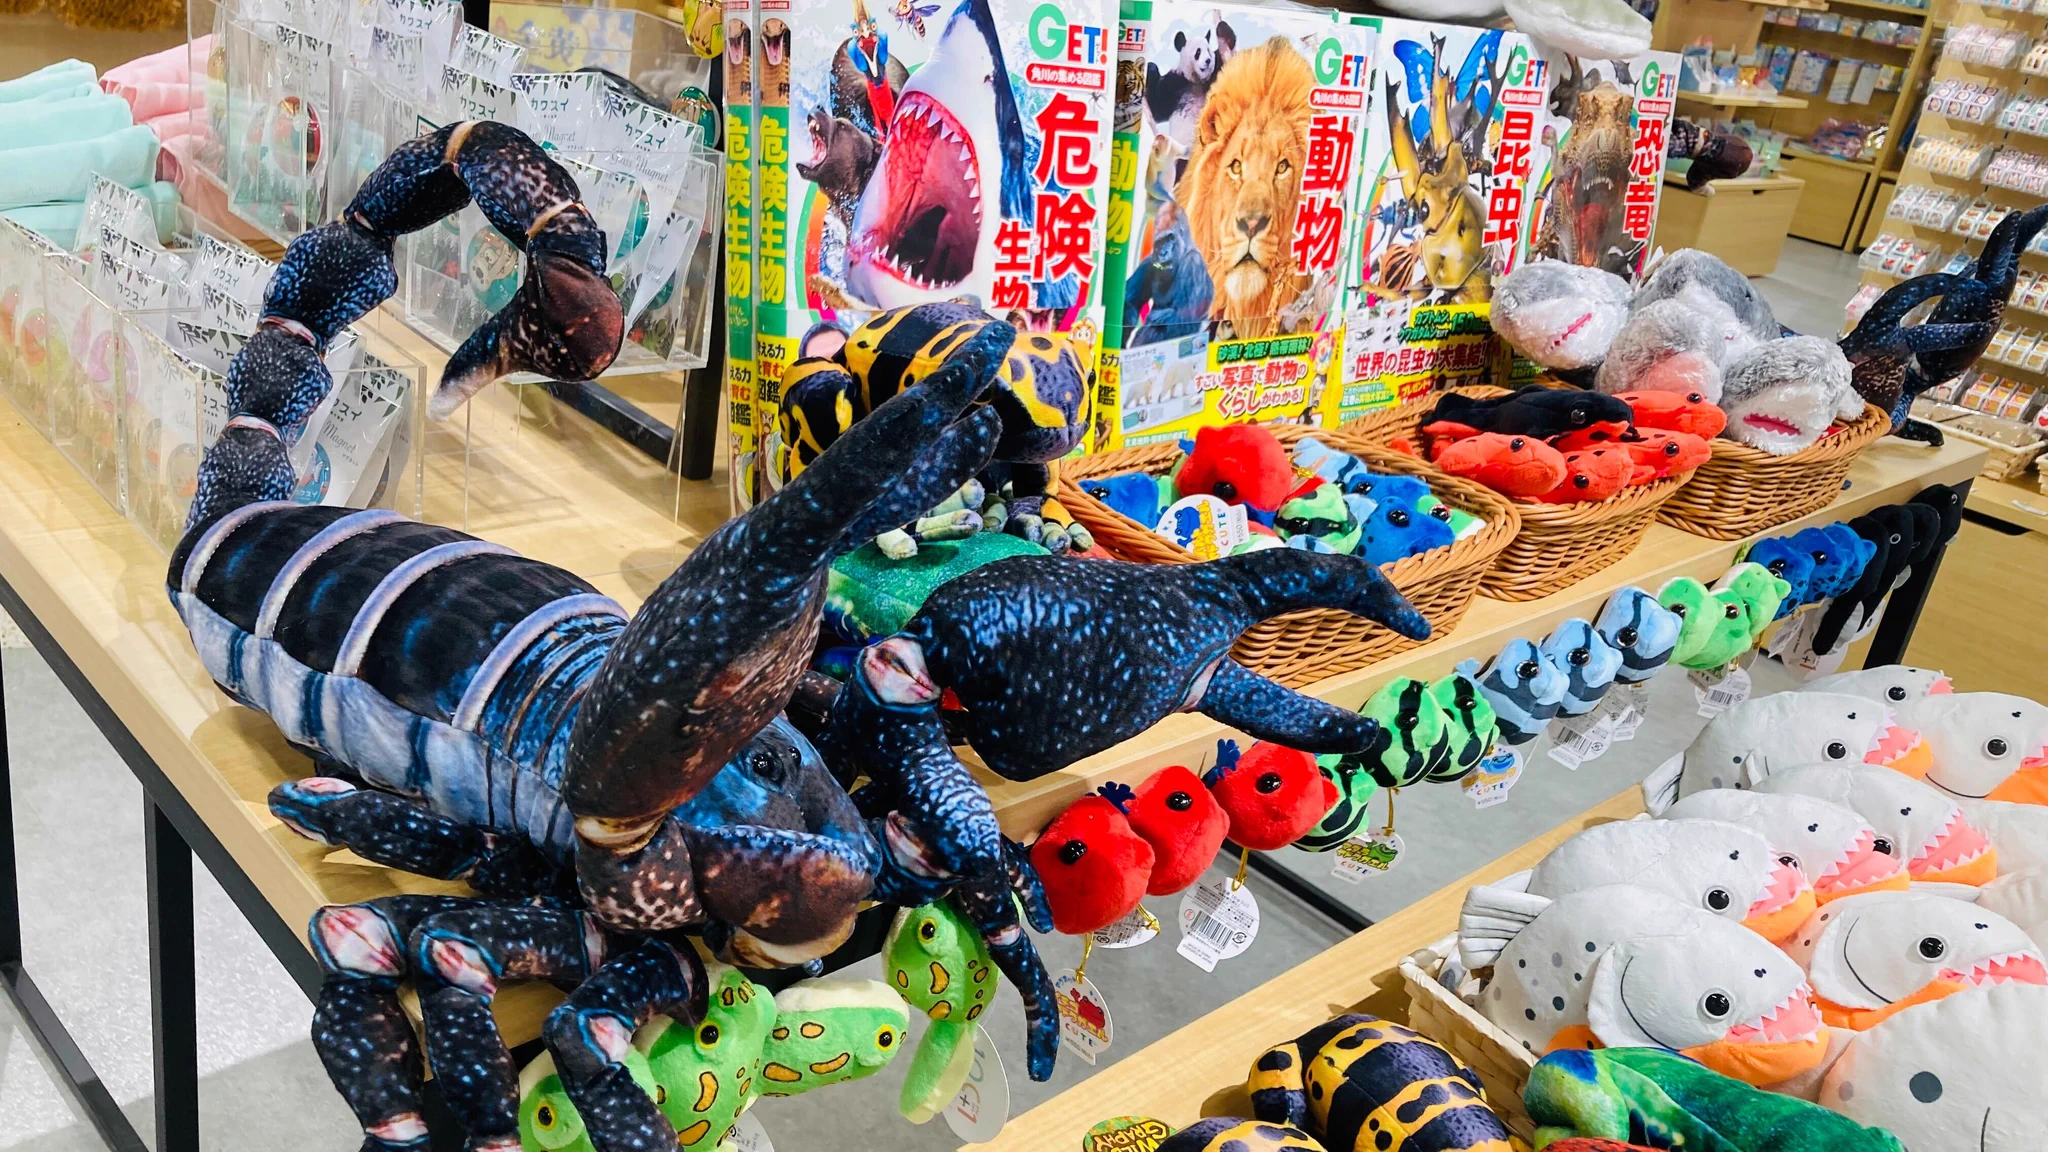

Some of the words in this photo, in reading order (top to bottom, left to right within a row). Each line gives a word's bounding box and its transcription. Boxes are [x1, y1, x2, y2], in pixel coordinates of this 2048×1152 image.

[400, 13, 432, 30] カワスイ
[1028, 3, 1108, 65] GET!
[1031, 67, 1101, 87] 角川の集める図鑑
[1315, 37, 1368, 88] GET!
[1507, 45, 1548, 88] GET!
[1642, 61, 1676, 98] GET!
[460, 95, 496, 120] カワスイ
[531, 98, 569, 112] カワスイ
[625, 123, 666, 149] カワスイ
[636, 155, 668, 182] Magnet
[1483, 111, 1534, 244] 昆虫
[1624, 120, 1664, 239] 恐竜
[760, 114, 788, 304] 危険生物
[1293, 115, 1354, 272] 動物
[118, 281, 148, 307] カワスイ
[323, 421, 357, 454] Magnet
[1218, 512, 1228, 546] CUTE
[1476, 783, 1504, 795] CUTE
[1341, 861, 1368, 874] CUTE
[1065, 1023, 1093, 1047] CUTE
[1094, 1121, 1167, 1152] GRAPHY
